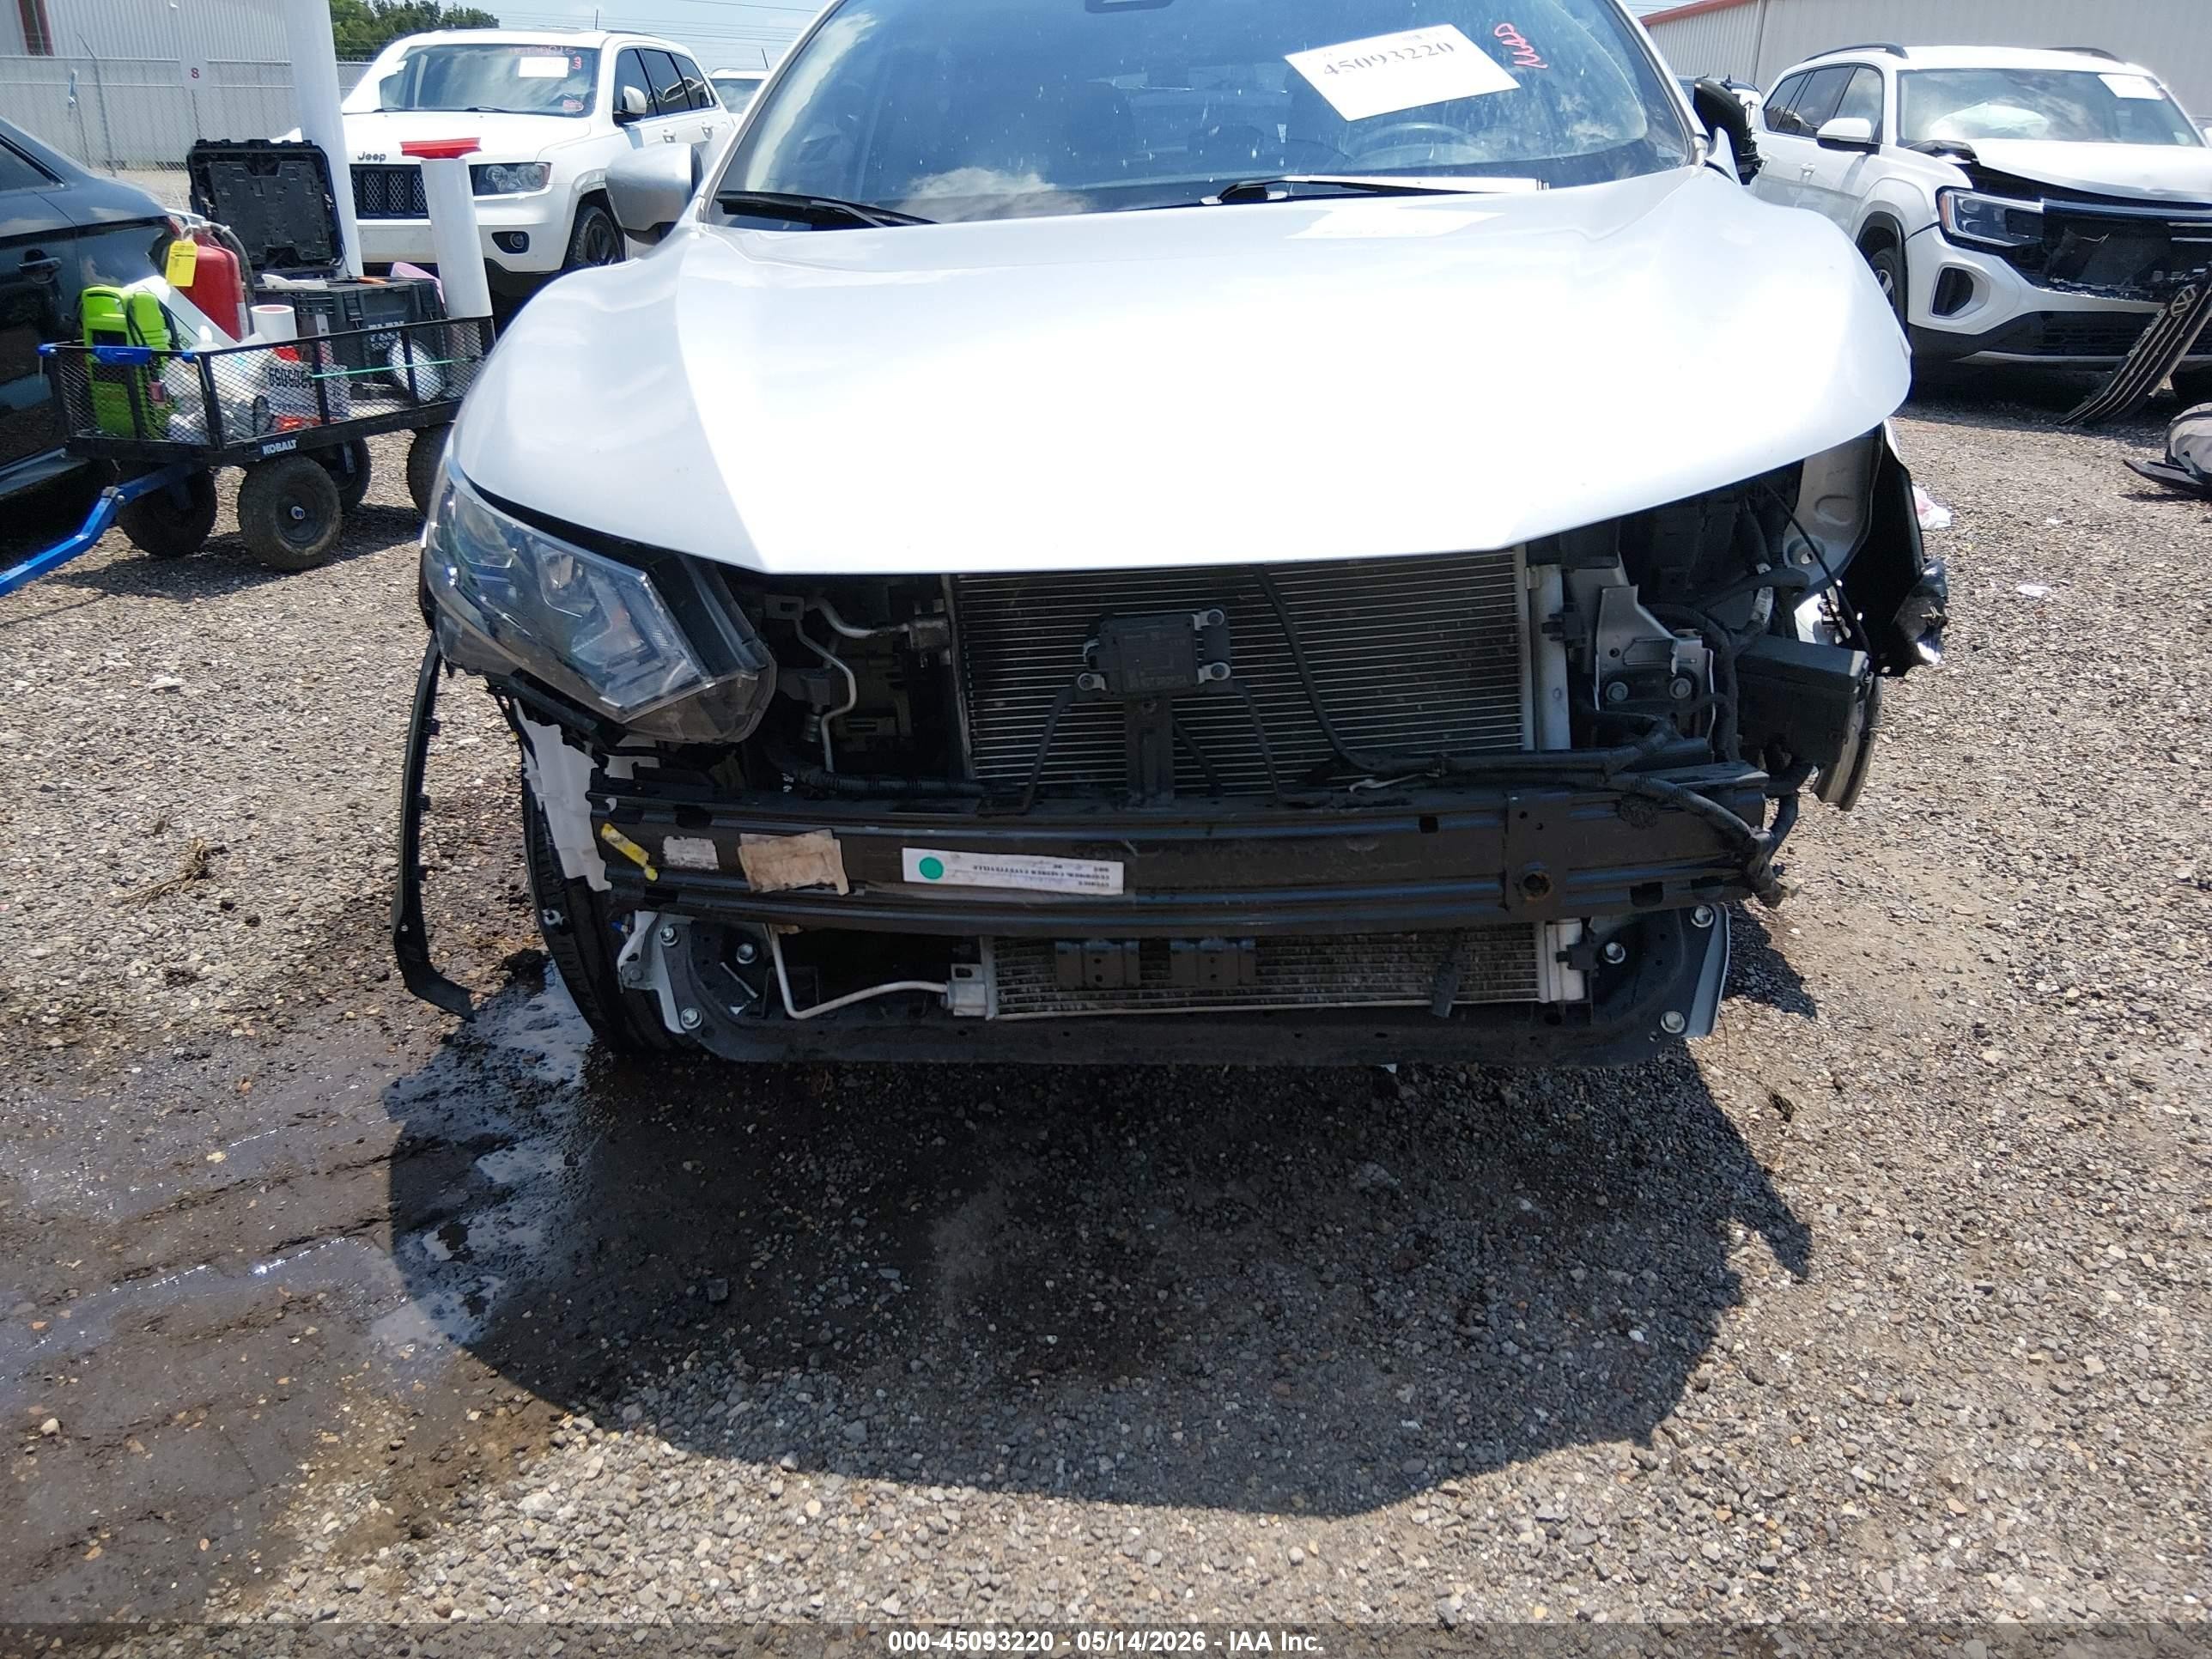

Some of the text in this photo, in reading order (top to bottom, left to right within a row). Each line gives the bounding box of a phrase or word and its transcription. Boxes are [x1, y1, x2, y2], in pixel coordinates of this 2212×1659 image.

[1323, 41, 1455, 76] 45093220
[191, 67, 200, 79] 8
[356, 151, 386, 162] Jeep
[262, 439, 297, 455] KOBALT
